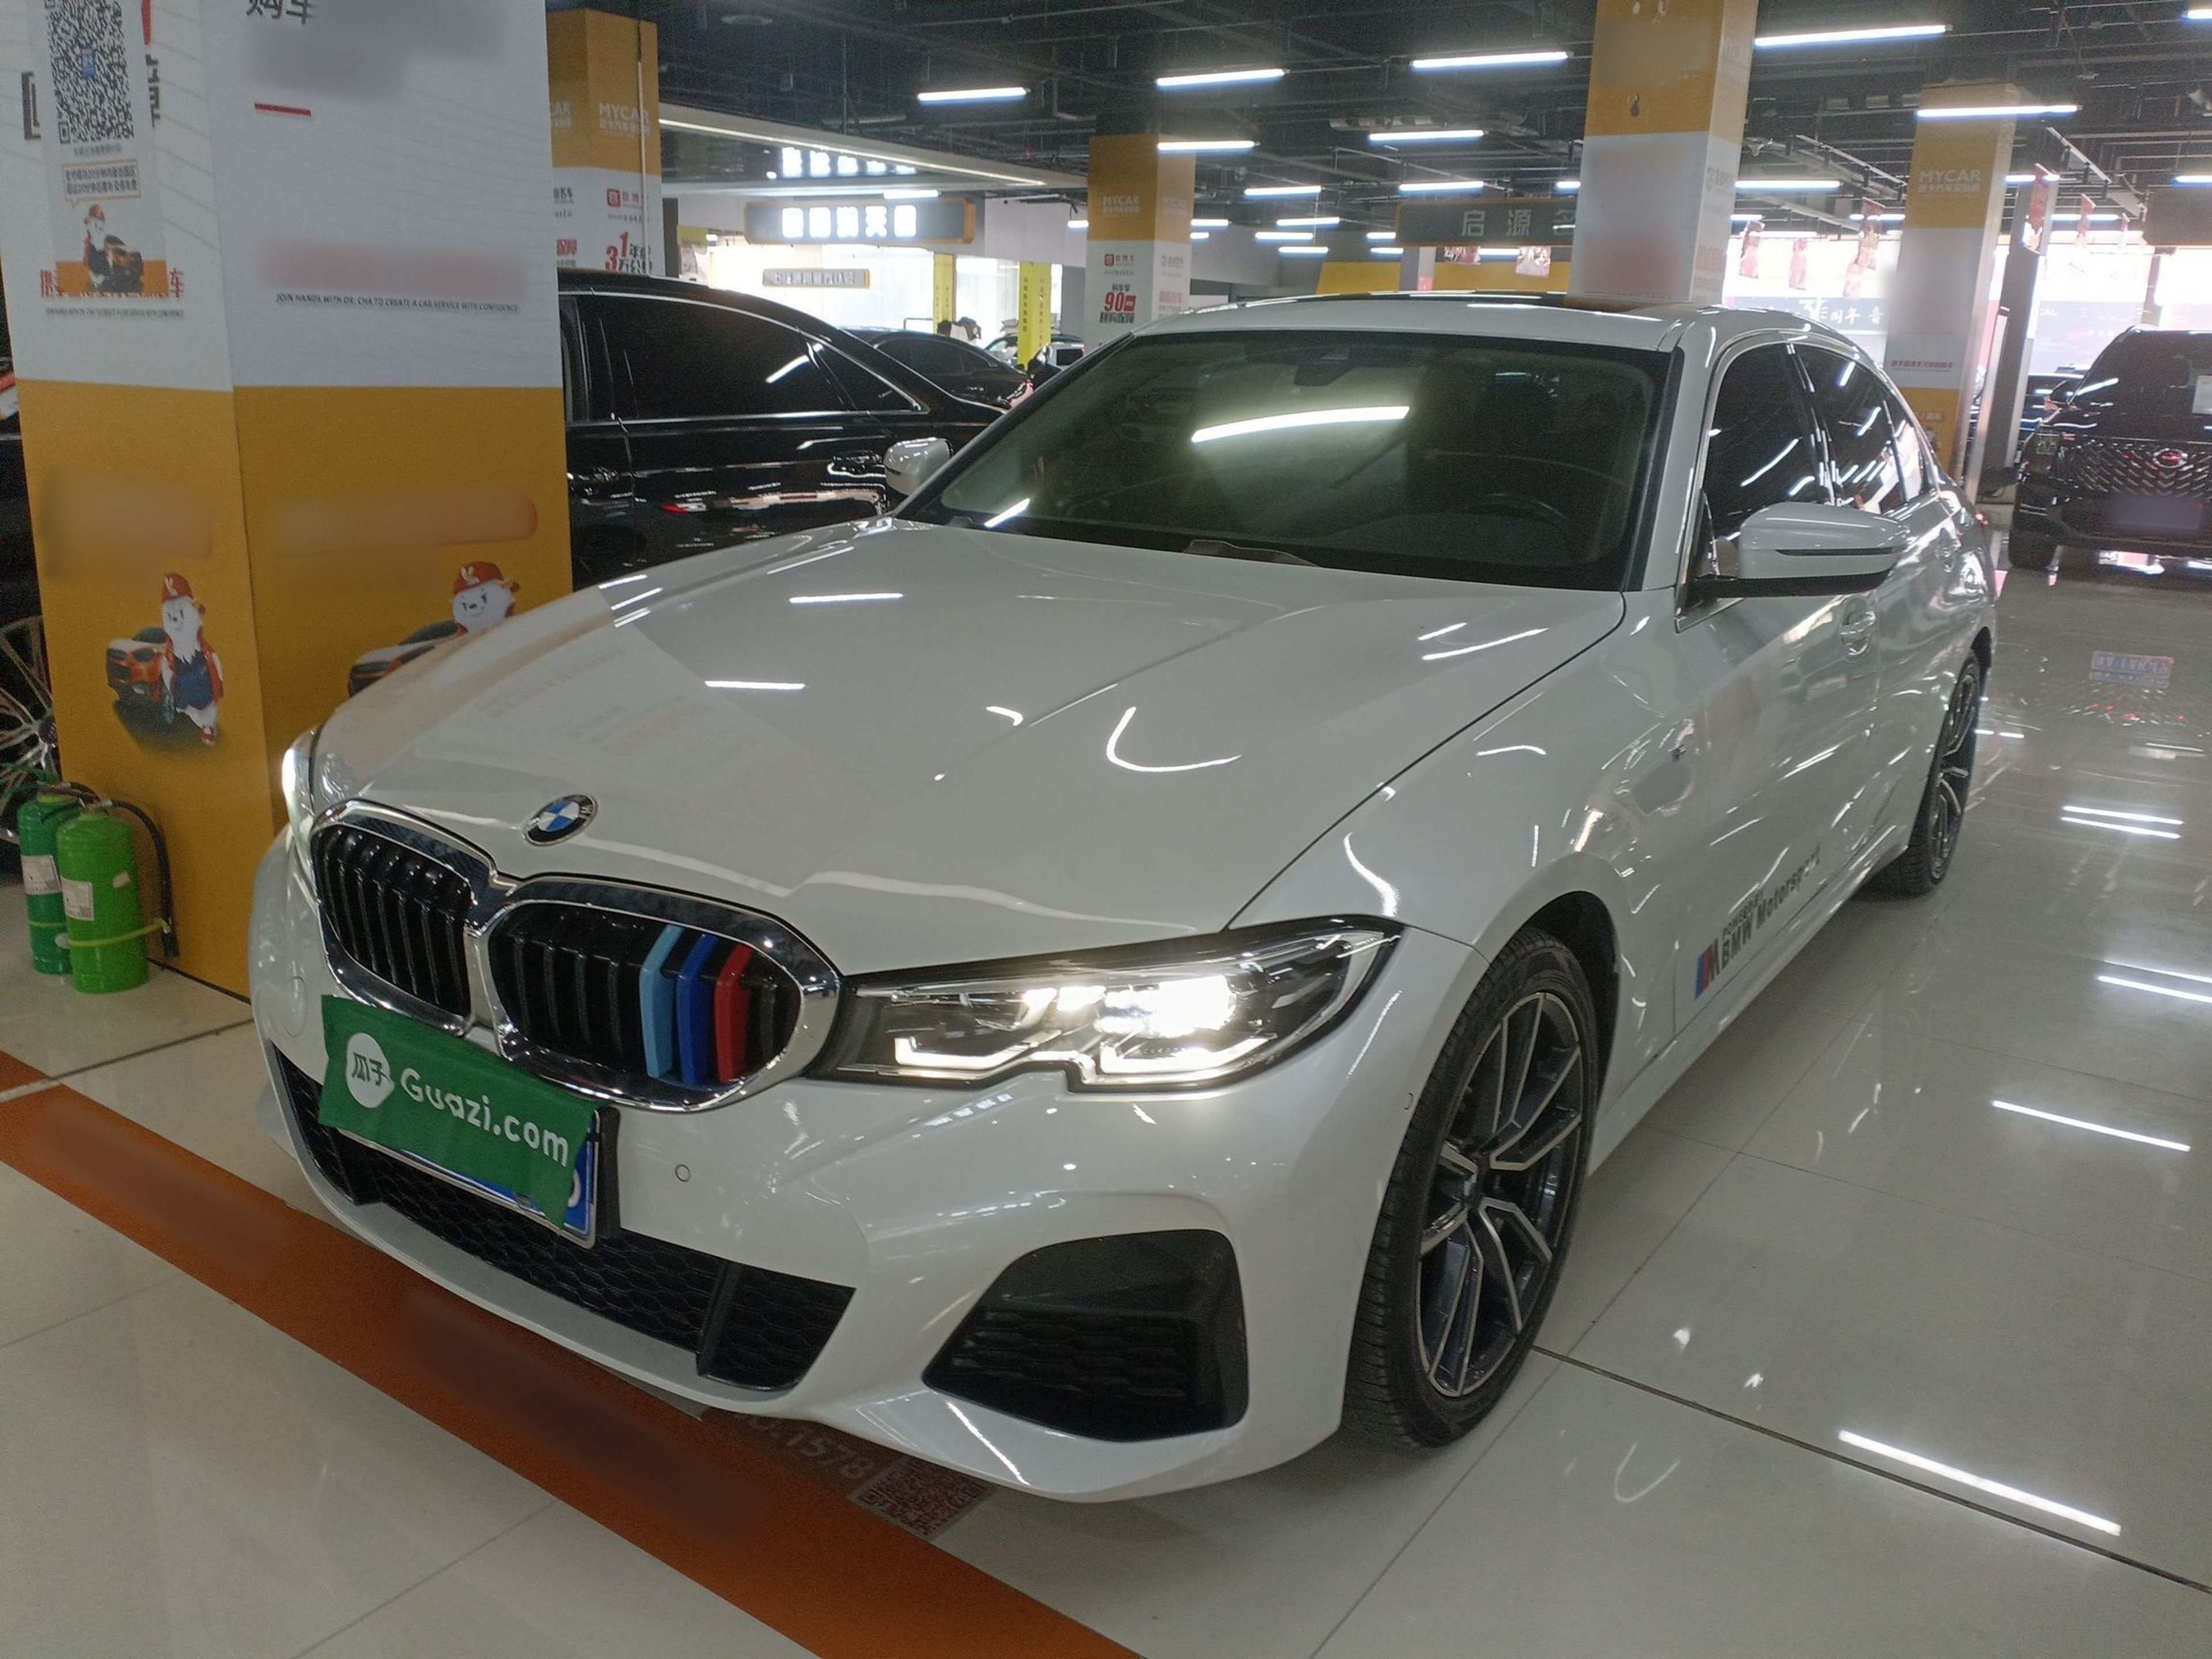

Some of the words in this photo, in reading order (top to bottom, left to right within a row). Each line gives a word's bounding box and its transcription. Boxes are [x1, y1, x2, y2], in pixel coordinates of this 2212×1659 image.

[1919, 169, 1982, 183] MYCAR
[276, 293, 293, 302] JOIN
[295, 294, 321, 302] HANDS
[323, 295, 342, 304] WITH
[351, 1051, 392, 1087] 瓜子
[400, 1067, 569, 1168] Guazi.com
